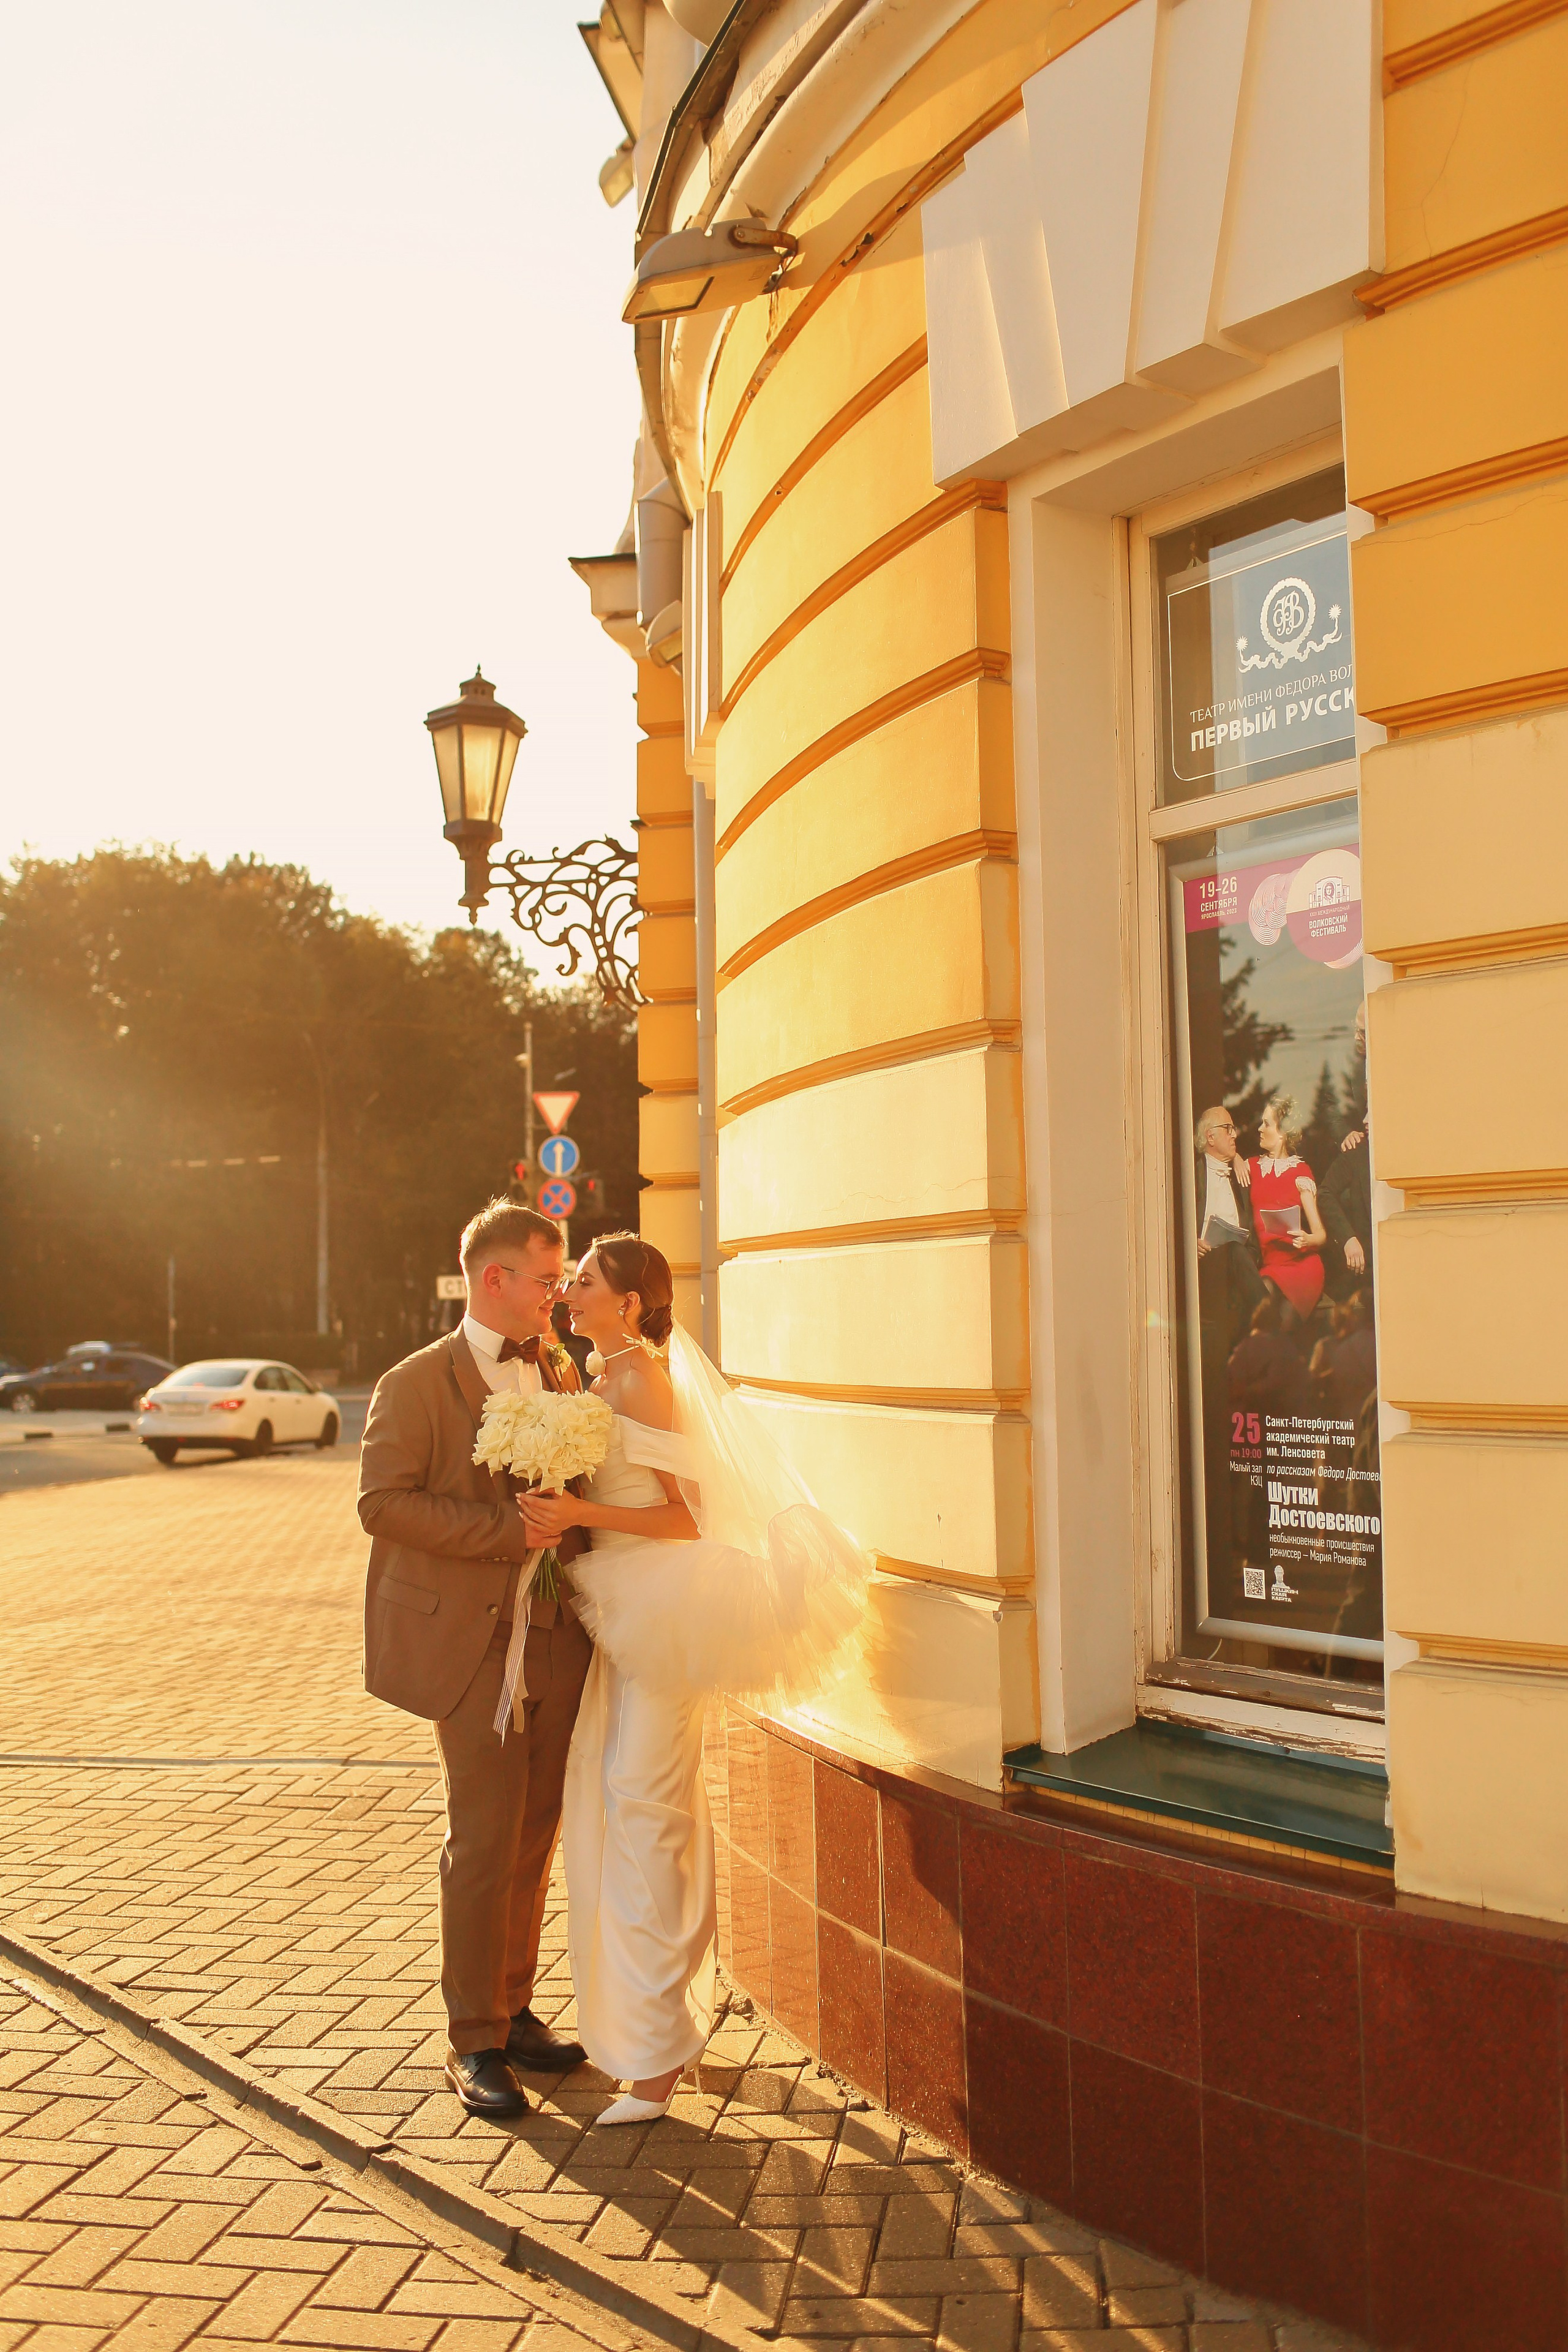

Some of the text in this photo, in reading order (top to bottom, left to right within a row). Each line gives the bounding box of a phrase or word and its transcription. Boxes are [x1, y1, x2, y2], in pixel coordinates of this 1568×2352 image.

[1190, 703, 1225, 723] ТЕАТР
[1228, 688, 1272, 712] ИМЕНИ
[1275, 673, 1326, 698] ФЕДОРА
[1191, 685, 1354, 752] ПЕРВЫЙ РУССК
[1200, 897, 1237, 912] СЕНТЯБРЯ
[1309, 913, 1348, 929] ВОЛКОВСКИЙ
[1311, 924, 1346, 938] ФЕСТИВАЛЬ
[1232, 1412, 1261, 1444] 25
[1265, 1415, 1354, 1431] Санкт-Петербургский
[1266, 1432, 1355, 1448] академический театр
[1231, 1448, 1262, 1458] пн 19:00
[1267, 1446, 1325, 1460] им. Ленсовета
[1230, 1461, 1262, 1473] Малый зал
[1267, 1465, 1275, 1474] по
[1276, 1465, 1316, 1477] рассказам
[1317, 1465, 1344, 1481] Фёдора
[1250, 1475, 1262, 1488] КЗЦ
[1267, 1481, 1319, 1506] Шутки
[1268, 1504, 1381, 1535] Достоевского
[1269, 1532, 1374, 1553] необыкновенные происшествия
[1270, 1548, 1302, 1561] режиссер
[1310, 1550, 1332, 1564] Мария
[1333, 1552, 1366, 1566] Романова
